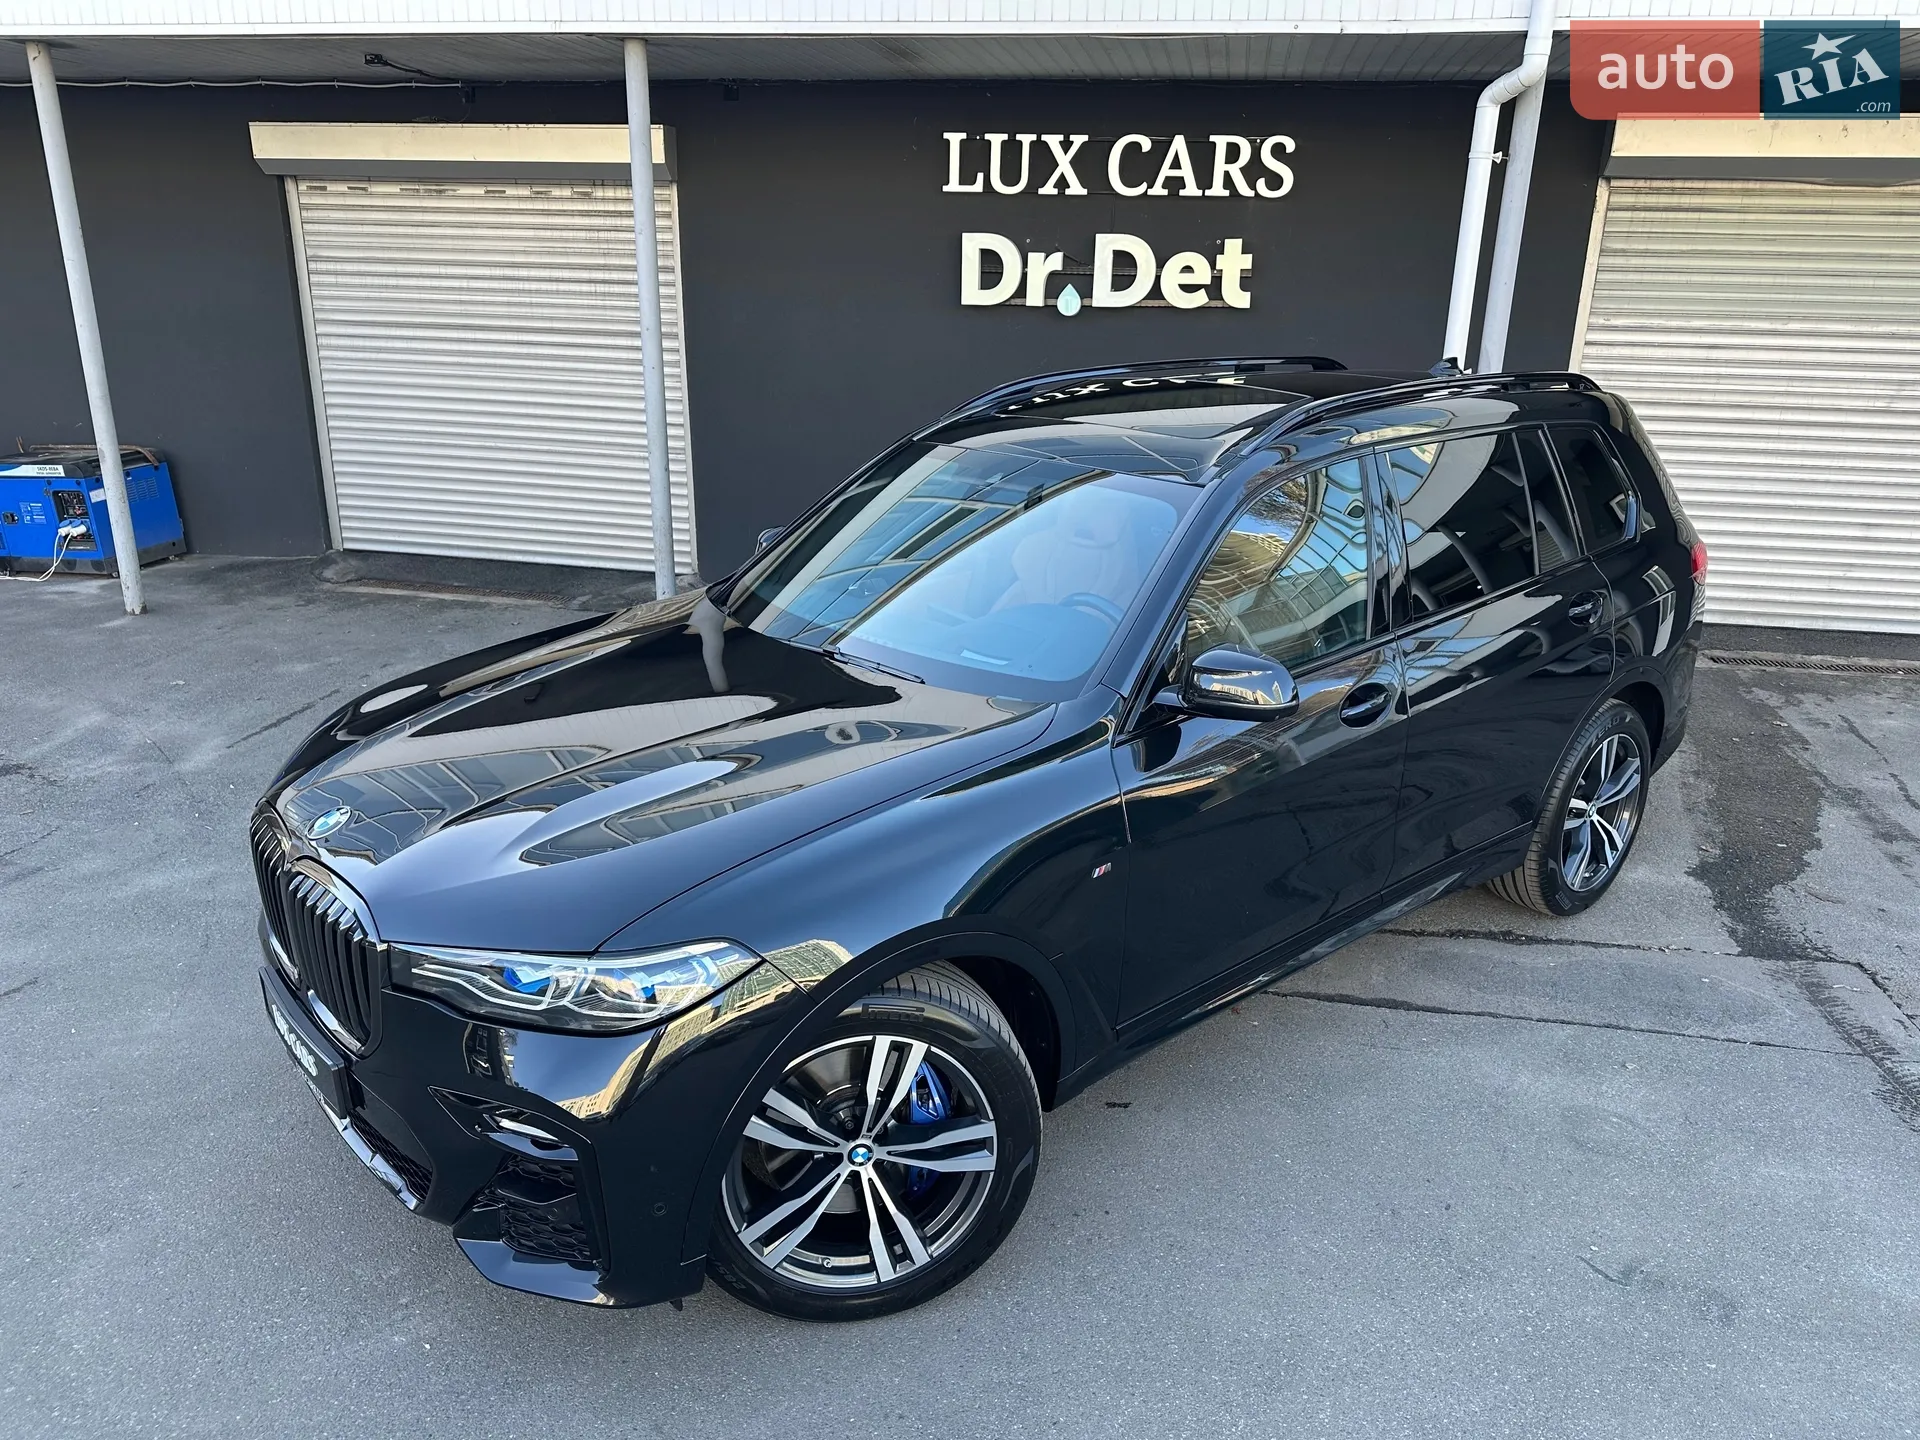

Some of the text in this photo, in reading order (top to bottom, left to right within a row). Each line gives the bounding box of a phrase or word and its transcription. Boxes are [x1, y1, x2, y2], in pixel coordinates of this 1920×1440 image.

[942, 132, 1296, 198] LUX CARS
[860, 1003, 925, 1022] PIRELLI
